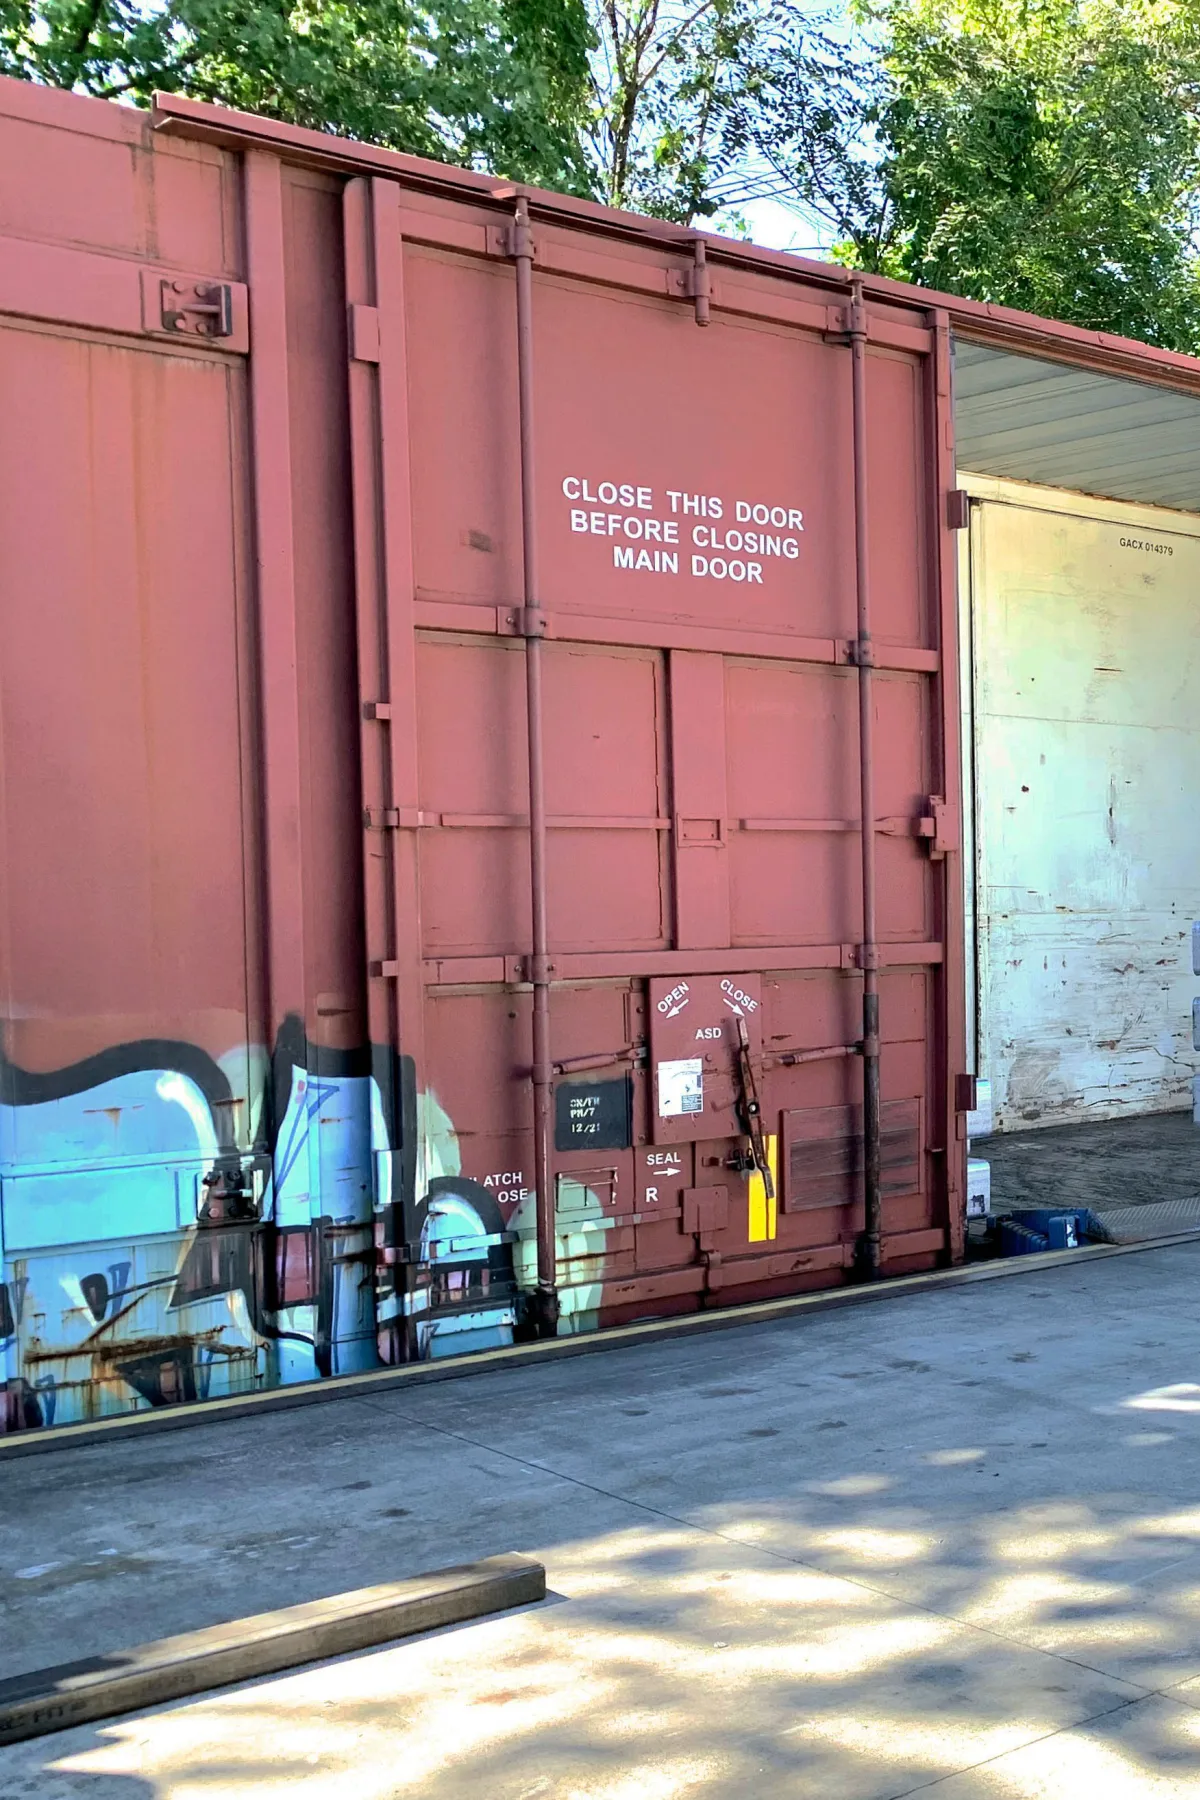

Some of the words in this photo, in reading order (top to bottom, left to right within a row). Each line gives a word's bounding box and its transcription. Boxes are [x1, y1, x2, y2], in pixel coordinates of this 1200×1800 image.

[562, 476, 653, 510] CLOSE
[666, 490, 723, 519] THIS
[735, 501, 804, 531] DOOR
[570, 509, 680, 544] BEFORE
[692, 525, 799, 559] CLOSING
[1119, 537, 1144, 550] GACX
[1145, 542, 1173, 556] 014379
[613, 545, 679, 574] MAIN
[691, 554, 763, 584] DOOR
[657, 981, 690, 1013] OPEN
[720, 979, 758, 1013] CLOSE
[695, 1027, 722, 1040] ASD
[646, 1152, 682, 1166] SEAL
[645, 1187, 659, 1203] R
